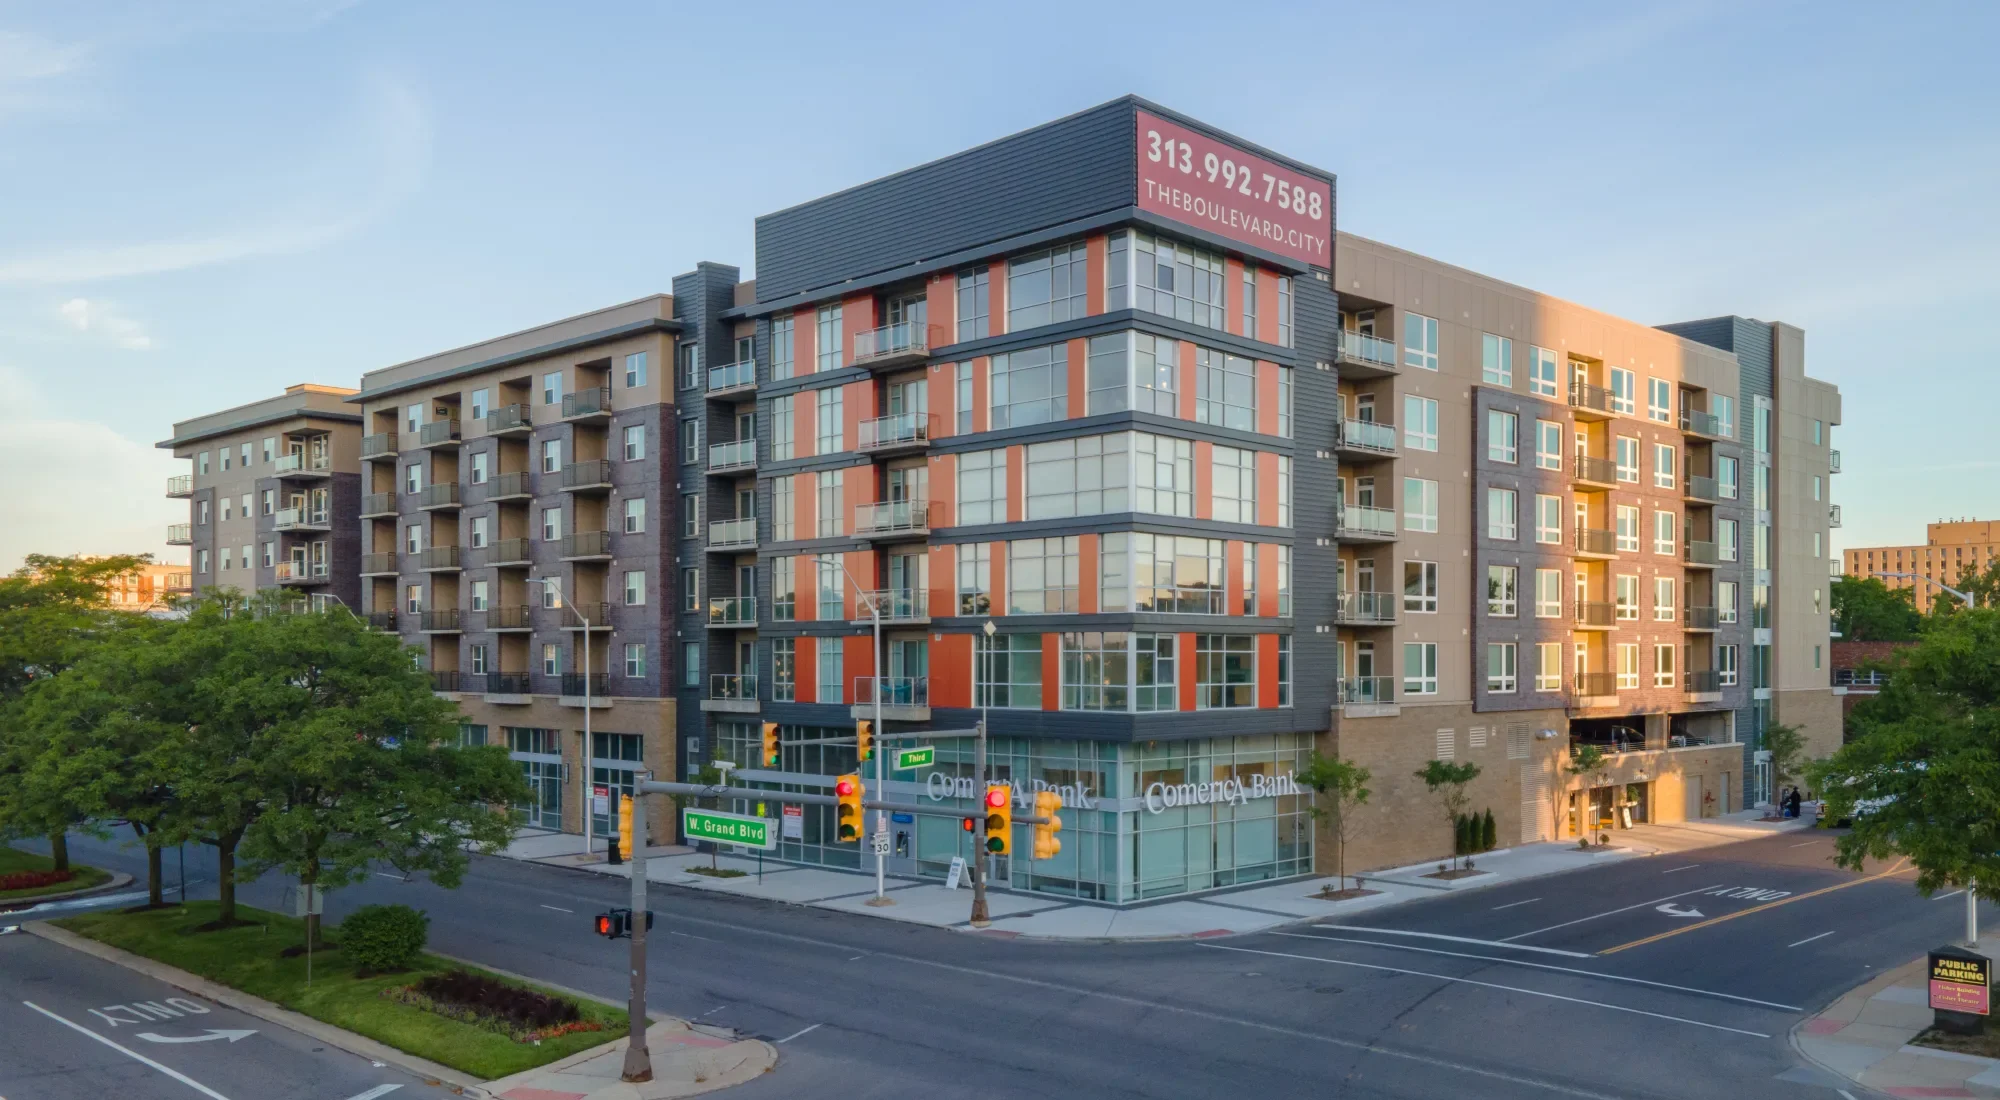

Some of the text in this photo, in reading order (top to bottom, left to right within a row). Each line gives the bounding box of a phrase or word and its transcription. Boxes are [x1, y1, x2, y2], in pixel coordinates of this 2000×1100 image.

[1147, 130, 1323, 220] 313.992.7588
[1144, 178, 1325, 255] THEBOULEVARD.CITY
[908, 753, 926, 764] Third
[1251, 769, 1302, 799] Bank
[689, 816, 764, 840] W. Grand Blvd
[877, 843, 889, 853] 30
[1703, 886, 1792, 901] ONLY
[1933, 967, 1985, 981] PARKING
[1938, 959, 1979, 971] PUBLIC
[87, 997, 211, 1027] ONLY
